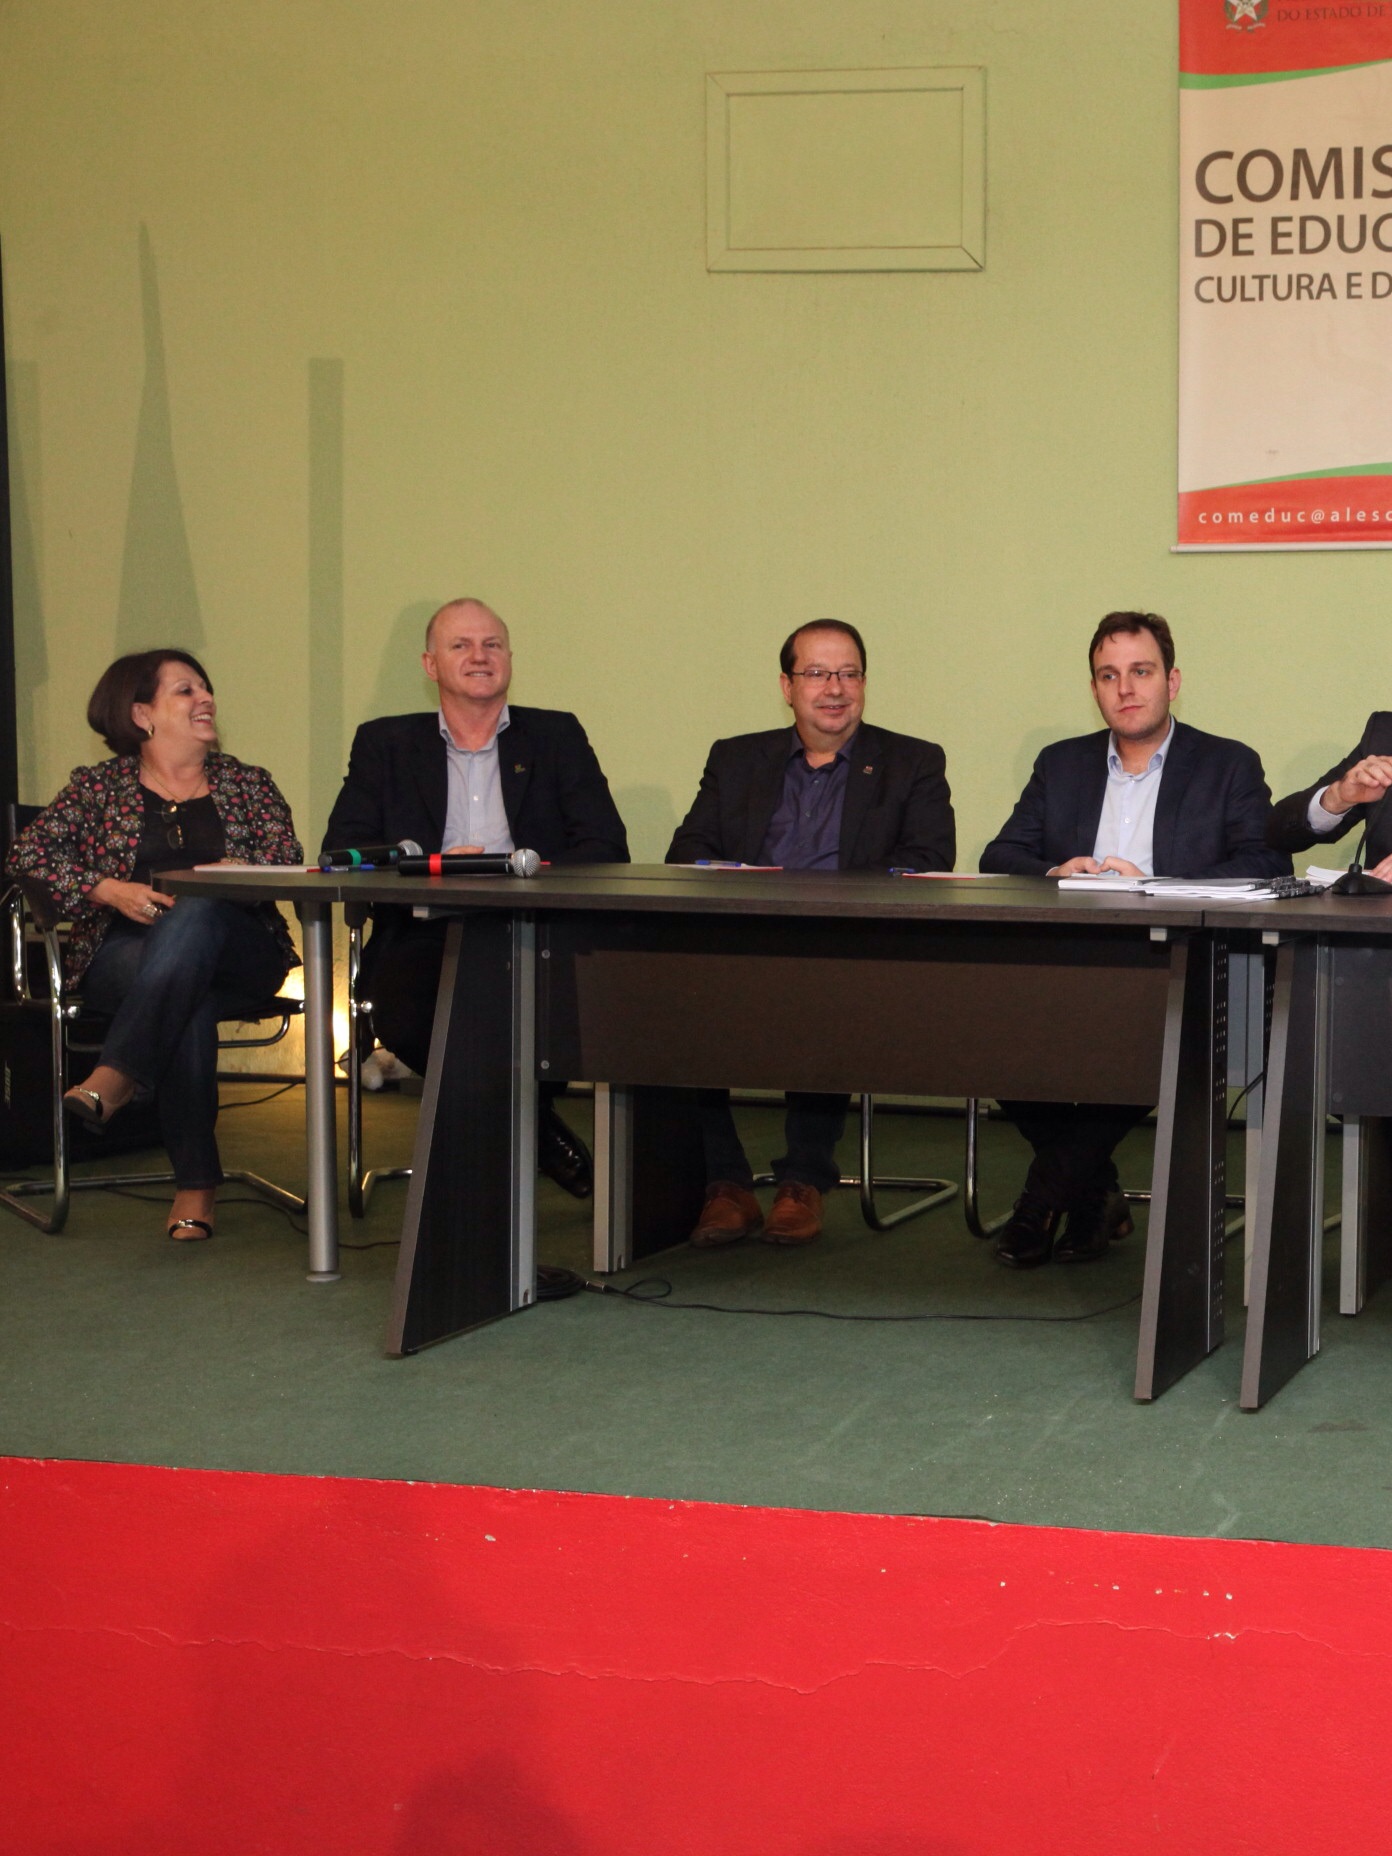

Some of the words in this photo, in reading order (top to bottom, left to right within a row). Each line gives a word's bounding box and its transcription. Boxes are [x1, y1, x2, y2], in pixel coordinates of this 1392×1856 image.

[1276, 9, 1300, 21] DO
[1306, 6, 1362, 20] ESTADO
[1367, 5, 1385, 17] DE
[1194, 218, 1255, 258] DE
[1194, 273, 1338, 304] CULTURA
[1346, 272, 1363, 300] E
